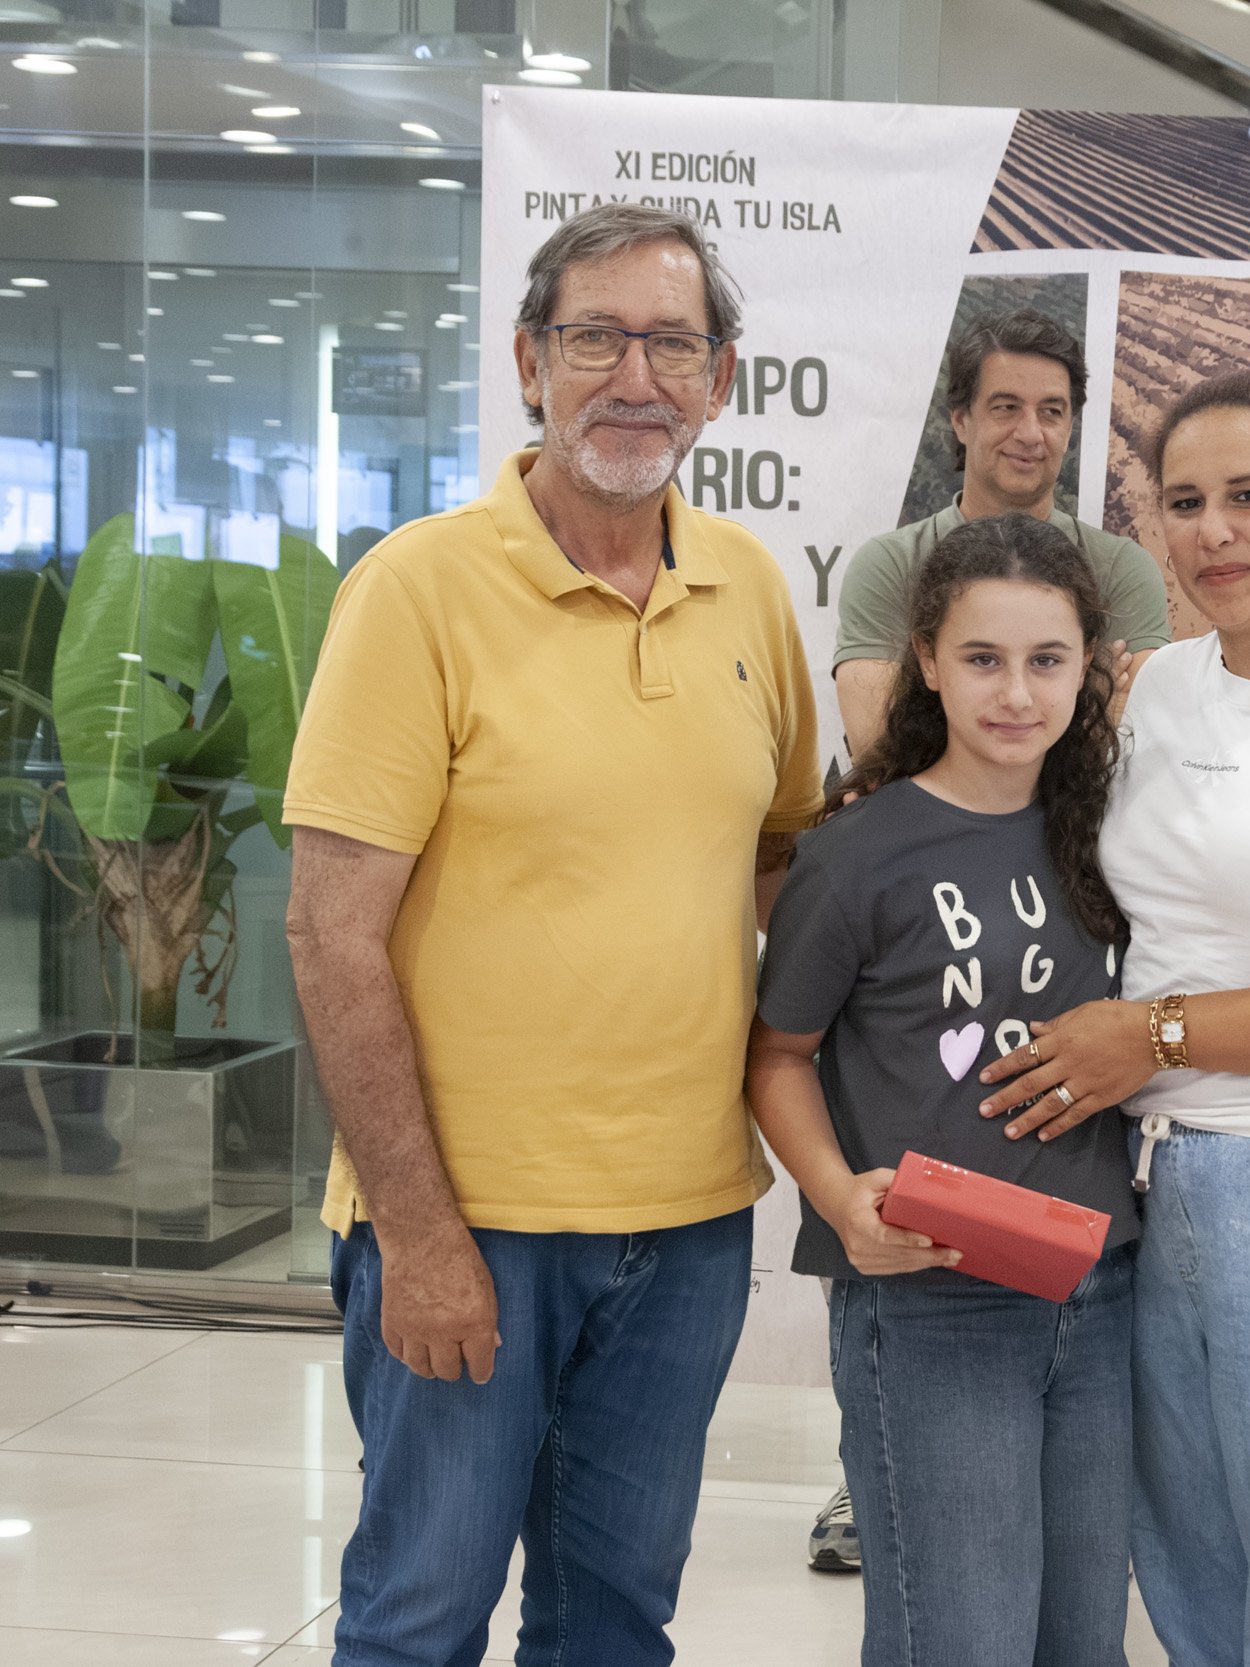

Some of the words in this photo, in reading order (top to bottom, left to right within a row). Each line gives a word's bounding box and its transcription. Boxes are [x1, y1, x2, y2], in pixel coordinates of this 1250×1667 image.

[614, 150, 641, 180] XI
[651, 150, 756, 187] EDICIÓN
[734, 199, 771, 229] TU
[782, 201, 842, 234] ISLA
[673, 446, 802, 513] RIO:
[804, 544, 843, 608] Y
